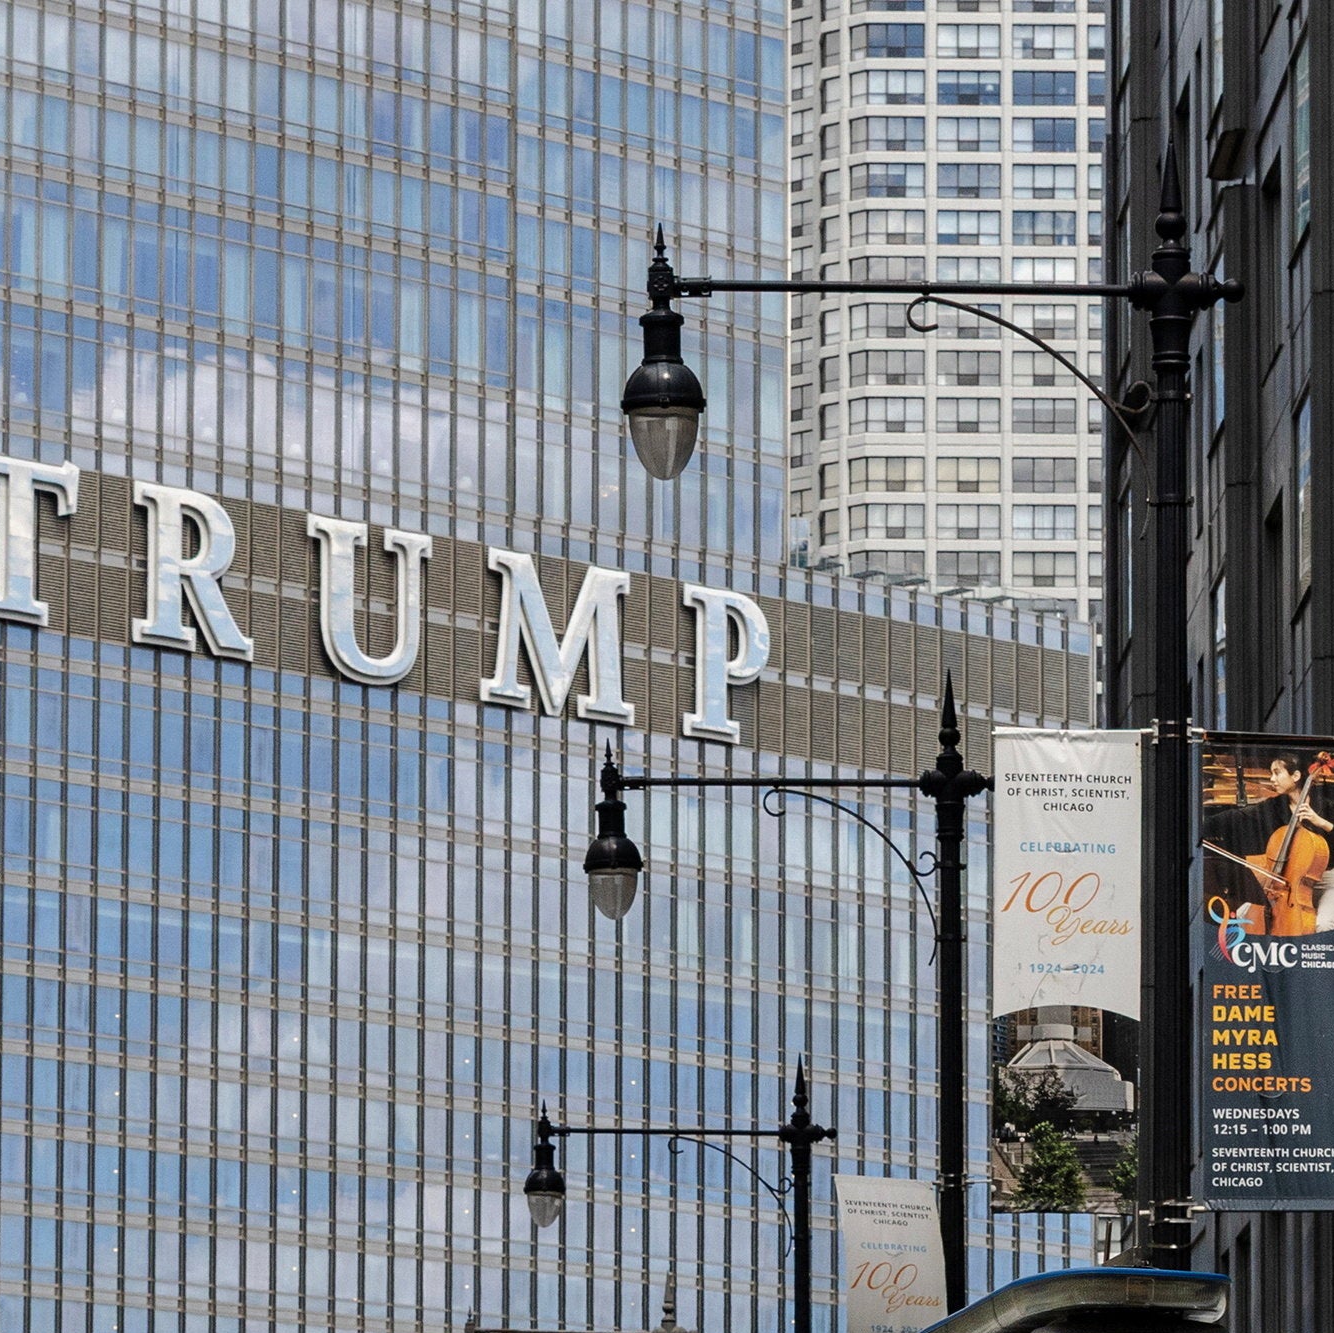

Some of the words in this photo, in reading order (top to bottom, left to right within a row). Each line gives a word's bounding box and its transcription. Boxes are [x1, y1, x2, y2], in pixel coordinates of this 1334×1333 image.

[1004, 772, 1082, 783] SEVENTEENTH
[1086, 774, 1132, 785] CHURCH
[1007, 787, 1021, 797] OF
[1025, 787, 1067, 798] CHRIST,
[1071, 788, 1130, 800] SCIENTIST,
[1043, 802, 1094, 812] CHICAGO
[1019, 841, 1116, 854] CELEBRATING
[1001, 871, 1101, 913] 100
[1046, 905, 1134, 946] Years
[1231, 941, 1298, 974] CMC
[1301, 952, 1326, 960] MUSIC
[1212, 984, 1263, 1000] FREE
[1212, 1005, 1275, 1022] DAME
[1212, 1029, 1279, 1046] MYRA
[1212, 1053, 1272, 1070] HESS
[1212, 1077, 1312, 1092] CONCERTS
[1212, 1108, 1300, 1120] WEDNESDAYS
[1213, 1124, 1248, 1135] 12:15
[1262, 1124, 1288, 1135] 1:00
[1292, 1124, 1312, 1135] PM
[1211, 1147, 1290, 1158] SEVENTEENTH
[1211, 1162, 1227, 1172] OF
[1230, 1162, 1273, 1174] CHRIST,
[1276, 1162, 1334, 1174] SCIENTIST,
[1211, 1177, 1264, 1187] CHICAGO
[844, 1199, 898, 1209] SEVENTEENTH
[900, 1203, 932, 1212] CHURCH
[847, 1207, 858, 1215] OF
[860, 1208, 890, 1218] CHRIST,
[891, 1211, 932, 1221] SCIENTIST,
[873, 1218, 909, 1227] CHICAGO
[860, 1241, 928, 1253] CELEBRATING
[851, 1261, 918, 1291] 100
[881, 1284, 942, 1314] Years
